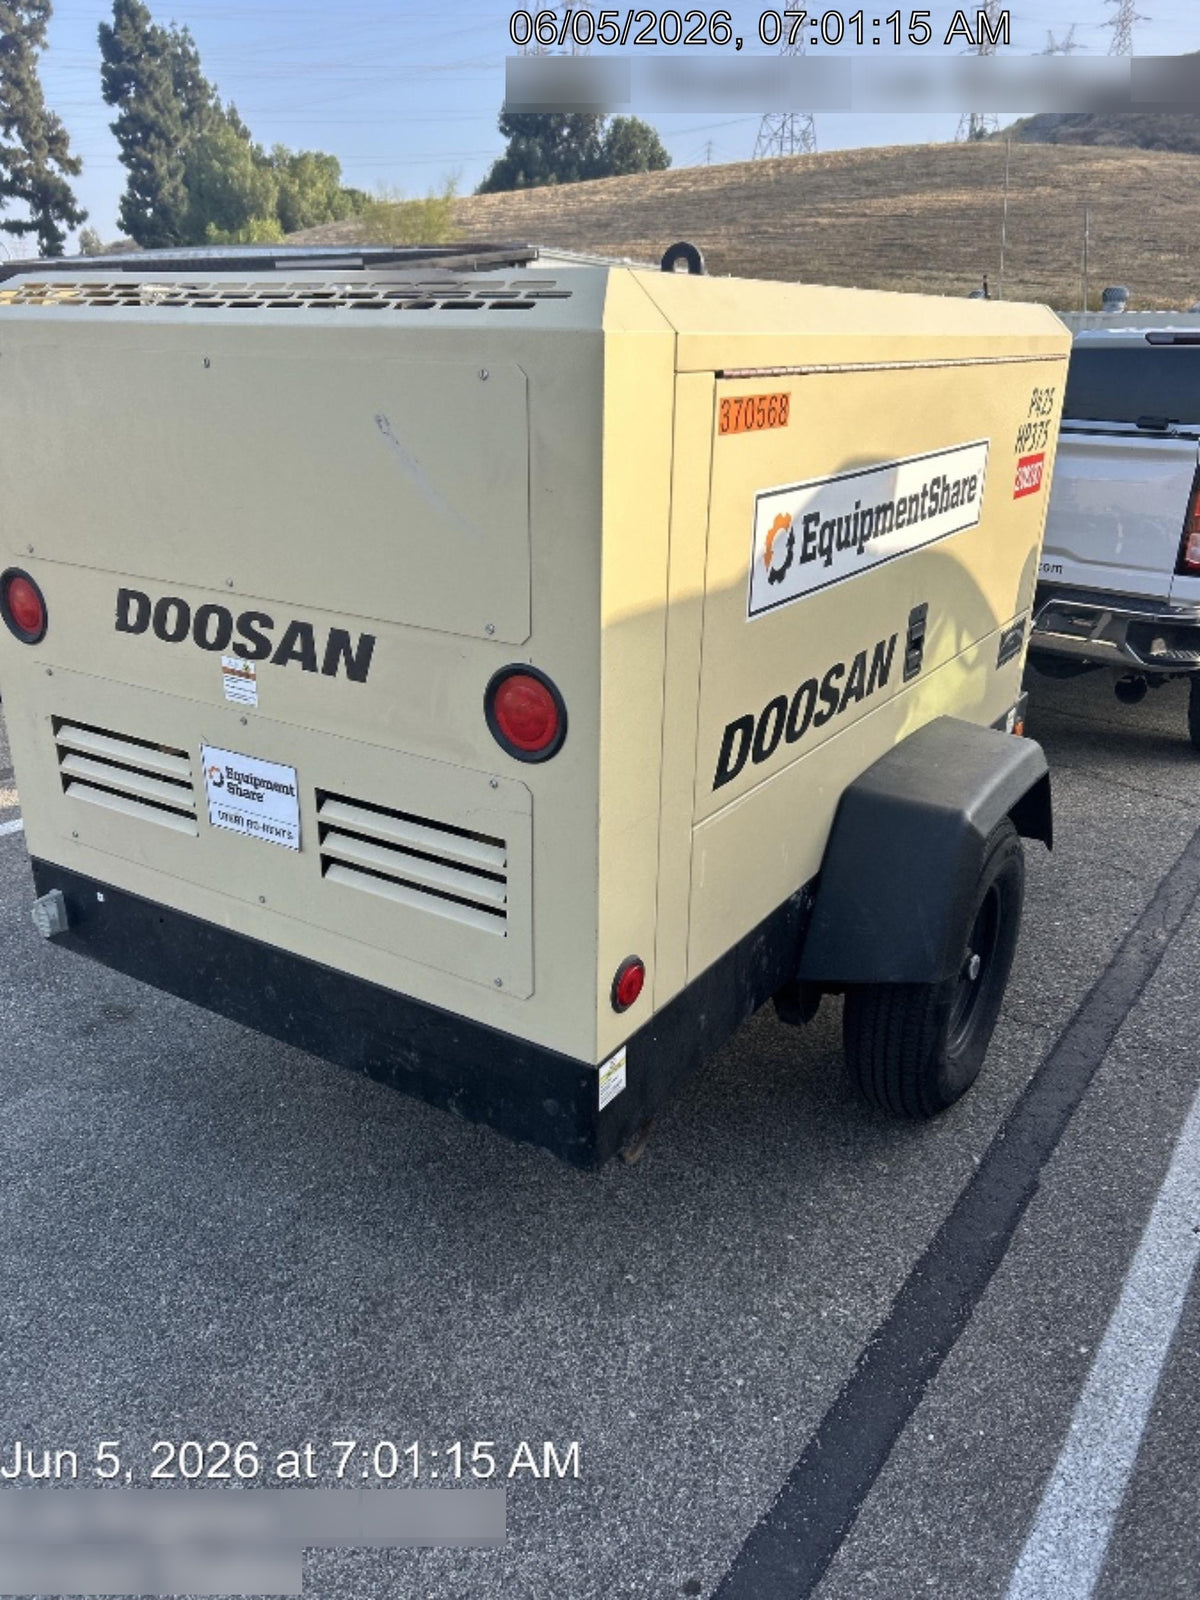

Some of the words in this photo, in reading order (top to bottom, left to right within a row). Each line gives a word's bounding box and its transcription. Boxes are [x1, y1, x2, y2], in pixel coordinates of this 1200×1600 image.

[721, 394, 789, 432] 370568
[1014, 419, 1052, 455] HP375
[799, 472, 978, 568] EquipmentShare
[115, 588, 377, 683] DOOSAN
[712, 633, 899, 792] DOOSAN
[225, 766, 296, 797] Equipment
[227, 781, 265, 803] Share
